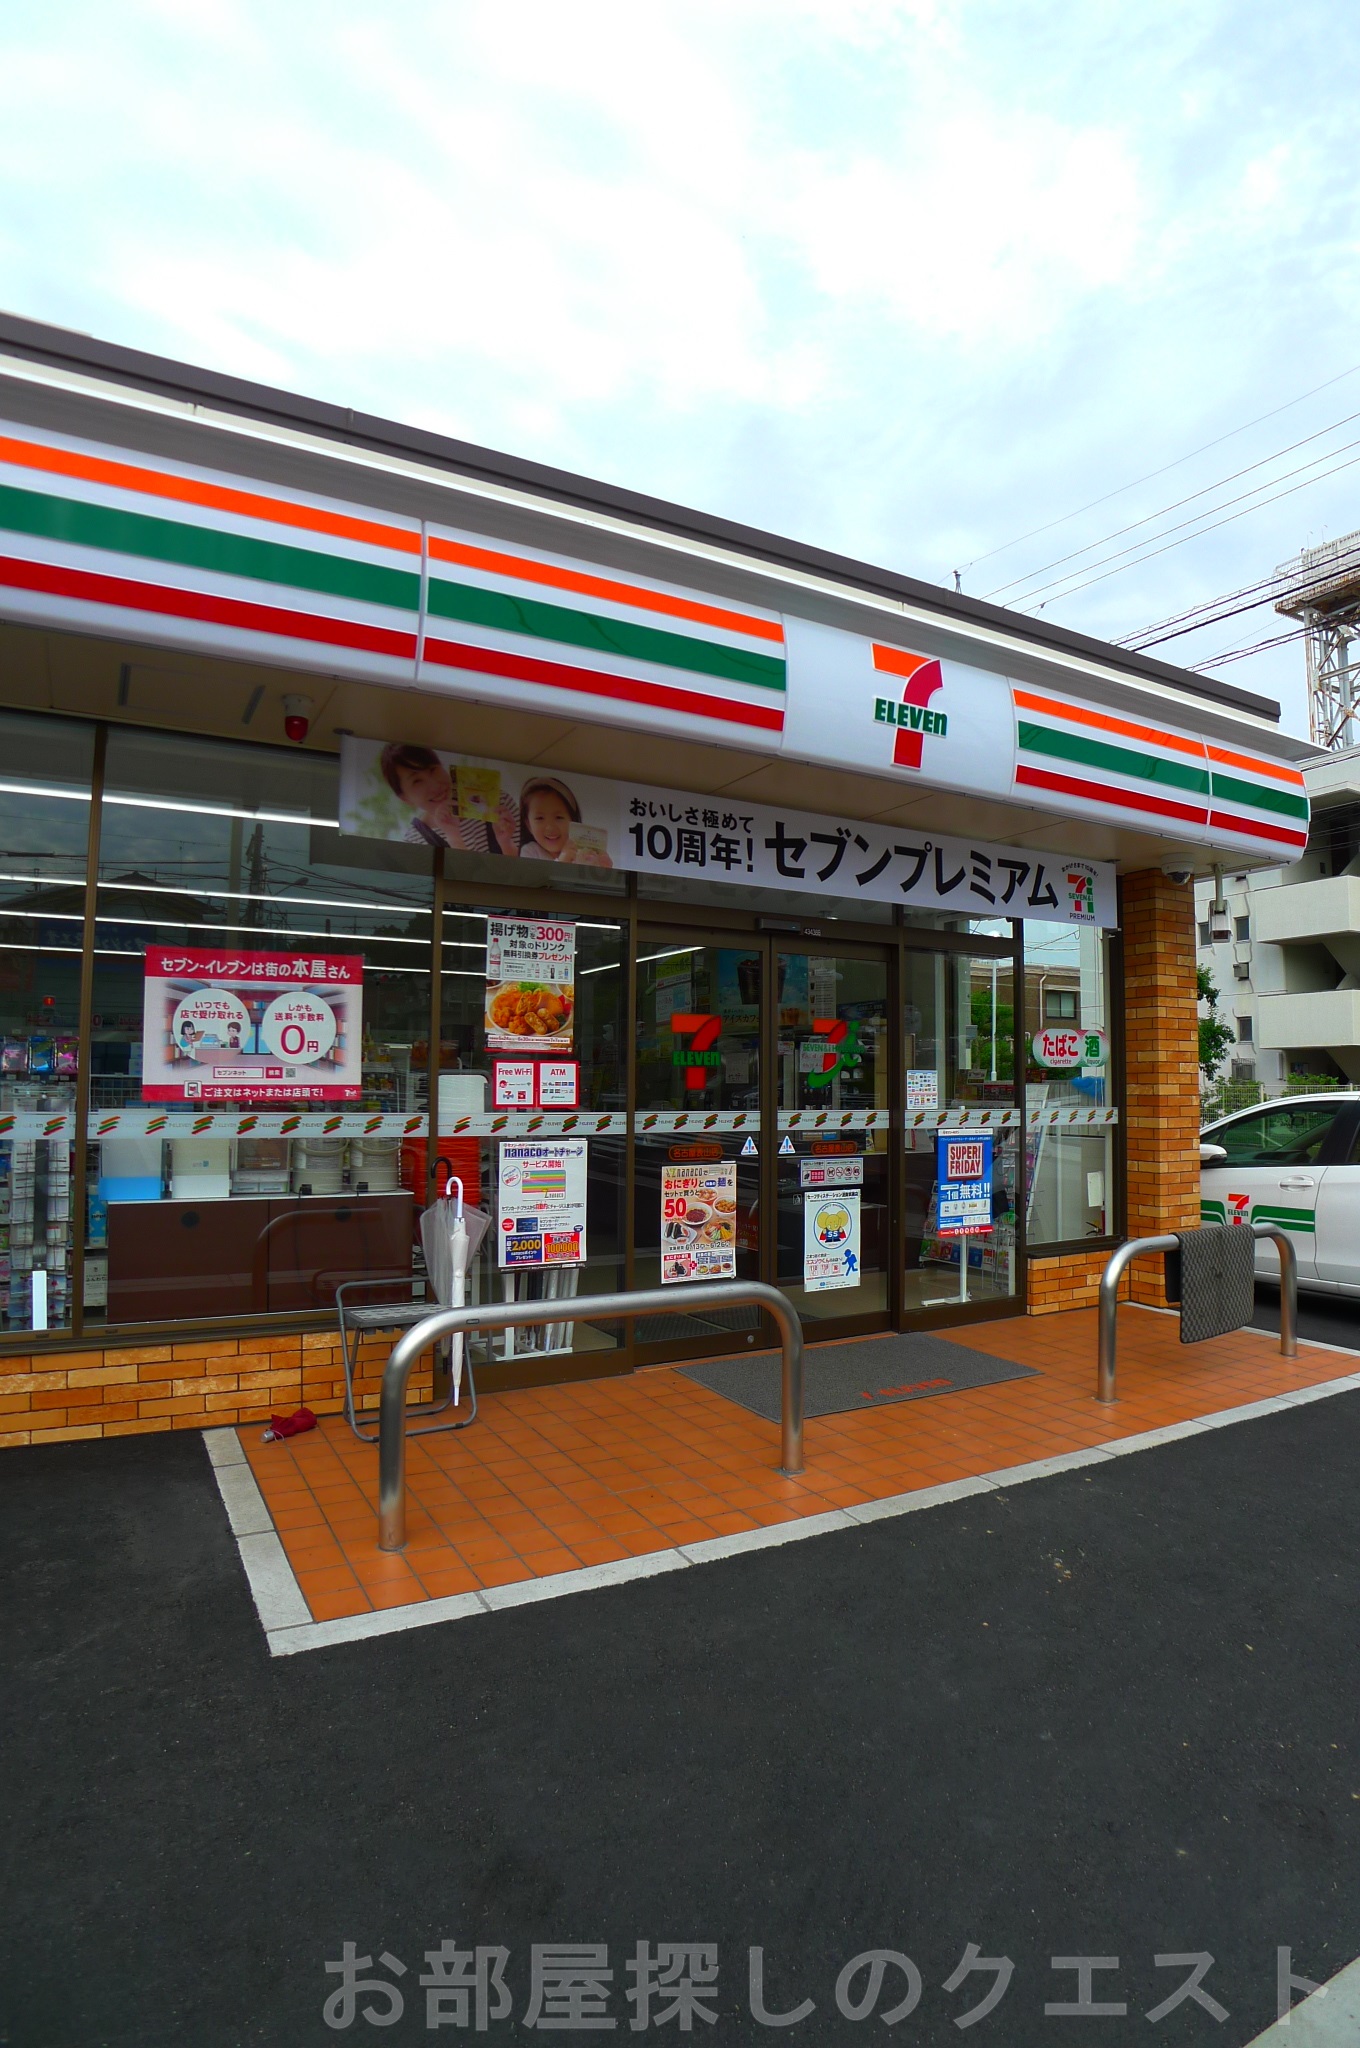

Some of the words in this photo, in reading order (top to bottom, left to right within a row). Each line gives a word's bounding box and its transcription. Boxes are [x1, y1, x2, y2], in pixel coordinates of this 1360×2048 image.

[870, 643, 944, 769] 7
[629, 798, 754, 833] おいしさ極めて
[629, 823, 754, 873] 10周年!
[765, 821, 1059, 909] セブンプレミアム
[1069, 913, 1096, 922] PREMIUM
[509, 940, 565, 951] 対象のドリンク
[195, 1002, 230, 1010] いつでも
[288, 1004, 312, 1012] しかも
[180, 1010, 244, 1020] 店で受け取れる
[274, 1012, 325, 1022] 送料・手数料
[1043, 1034, 1079, 1057] たばこ
[1085, 1035, 1100, 1057] 酒
[670, 1013, 722, 1090] 7
[498, 1068, 513, 1076] Free
[515, 1068, 532, 1076] Wi-Fi
[204, 1087, 324, 1097] ご注文はネットまたは店頭で!
[522, 1160, 565, 1169] サービス開始!
[950, 1160, 981, 1175] FRIDAY
[959, 1183, 990, 1199] 無料!!
[664, 1197, 687, 1218] 50
[827, 1230, 838, 1238] SS
[512, 1239, 541, 1251] 2,000
